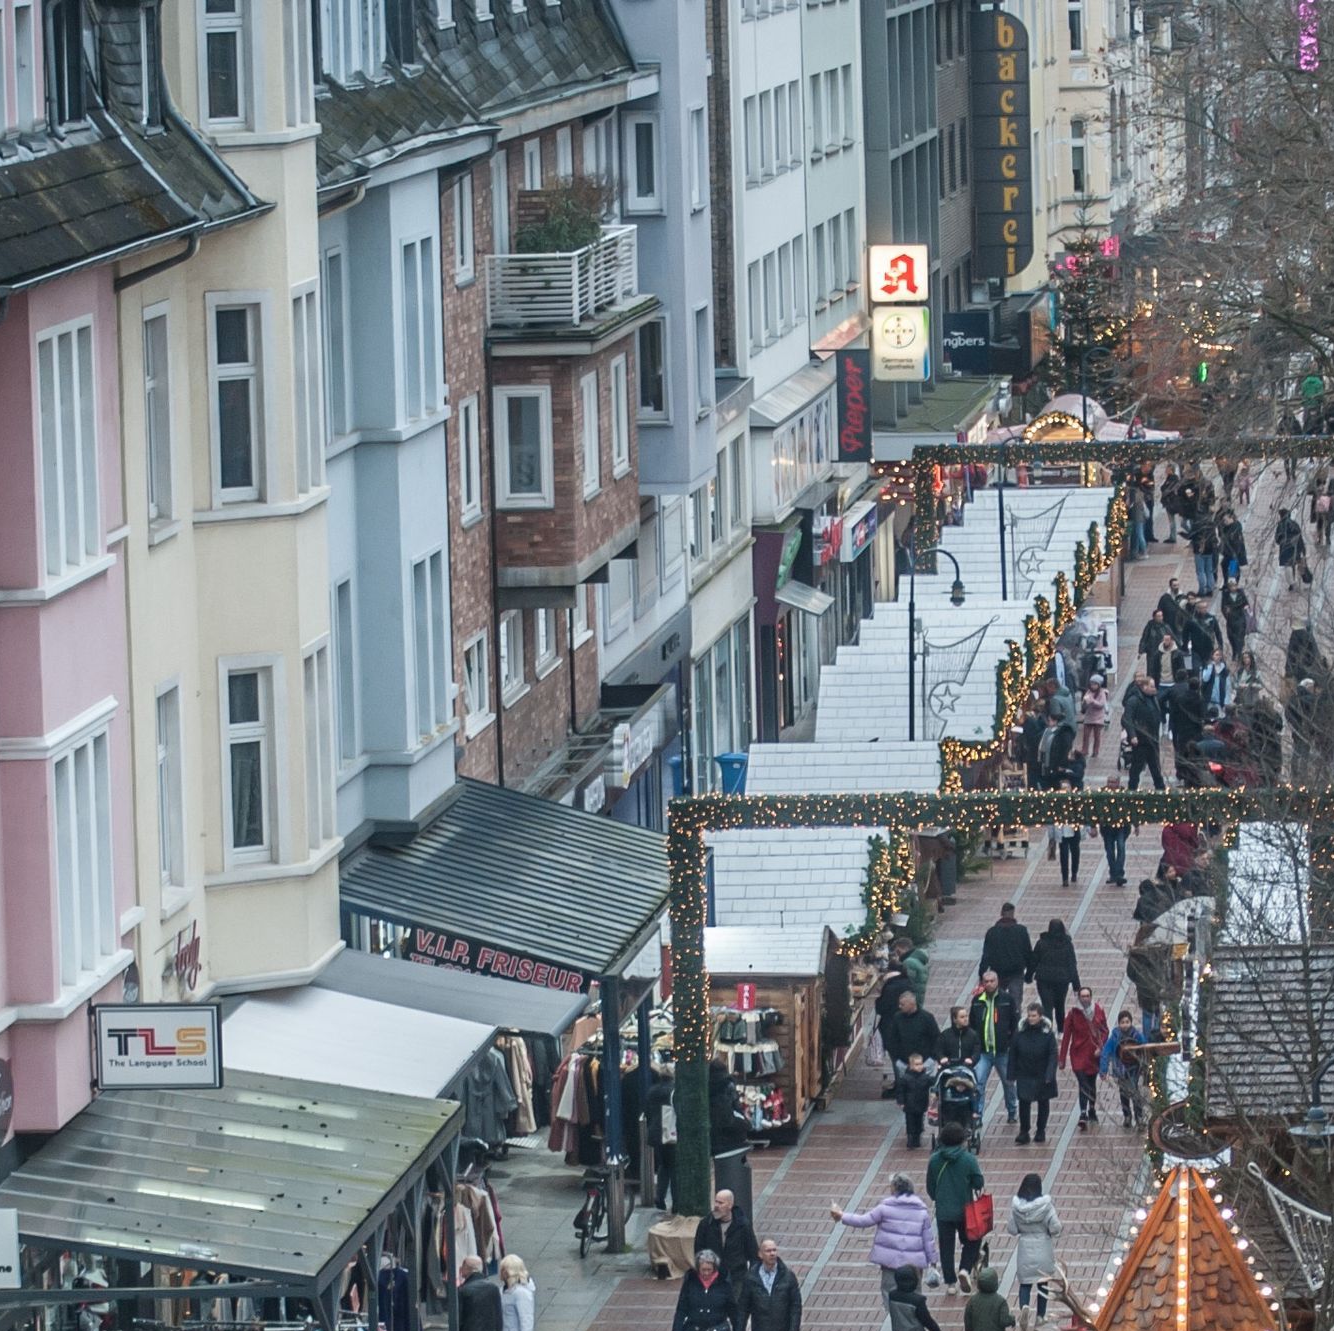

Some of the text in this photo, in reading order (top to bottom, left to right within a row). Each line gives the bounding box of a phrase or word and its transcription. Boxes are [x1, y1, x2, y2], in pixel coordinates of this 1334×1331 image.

[997, 15, 1020, 275] bäckerei
[943, 334, 986, 348] ngbers
[841, 356, 865, 453] Pieper
[476, 946, 584, 994] FRISEUR
[107, 1027, 207, 1057] TLS
[109, 1058, 208, 1069] The Language School
